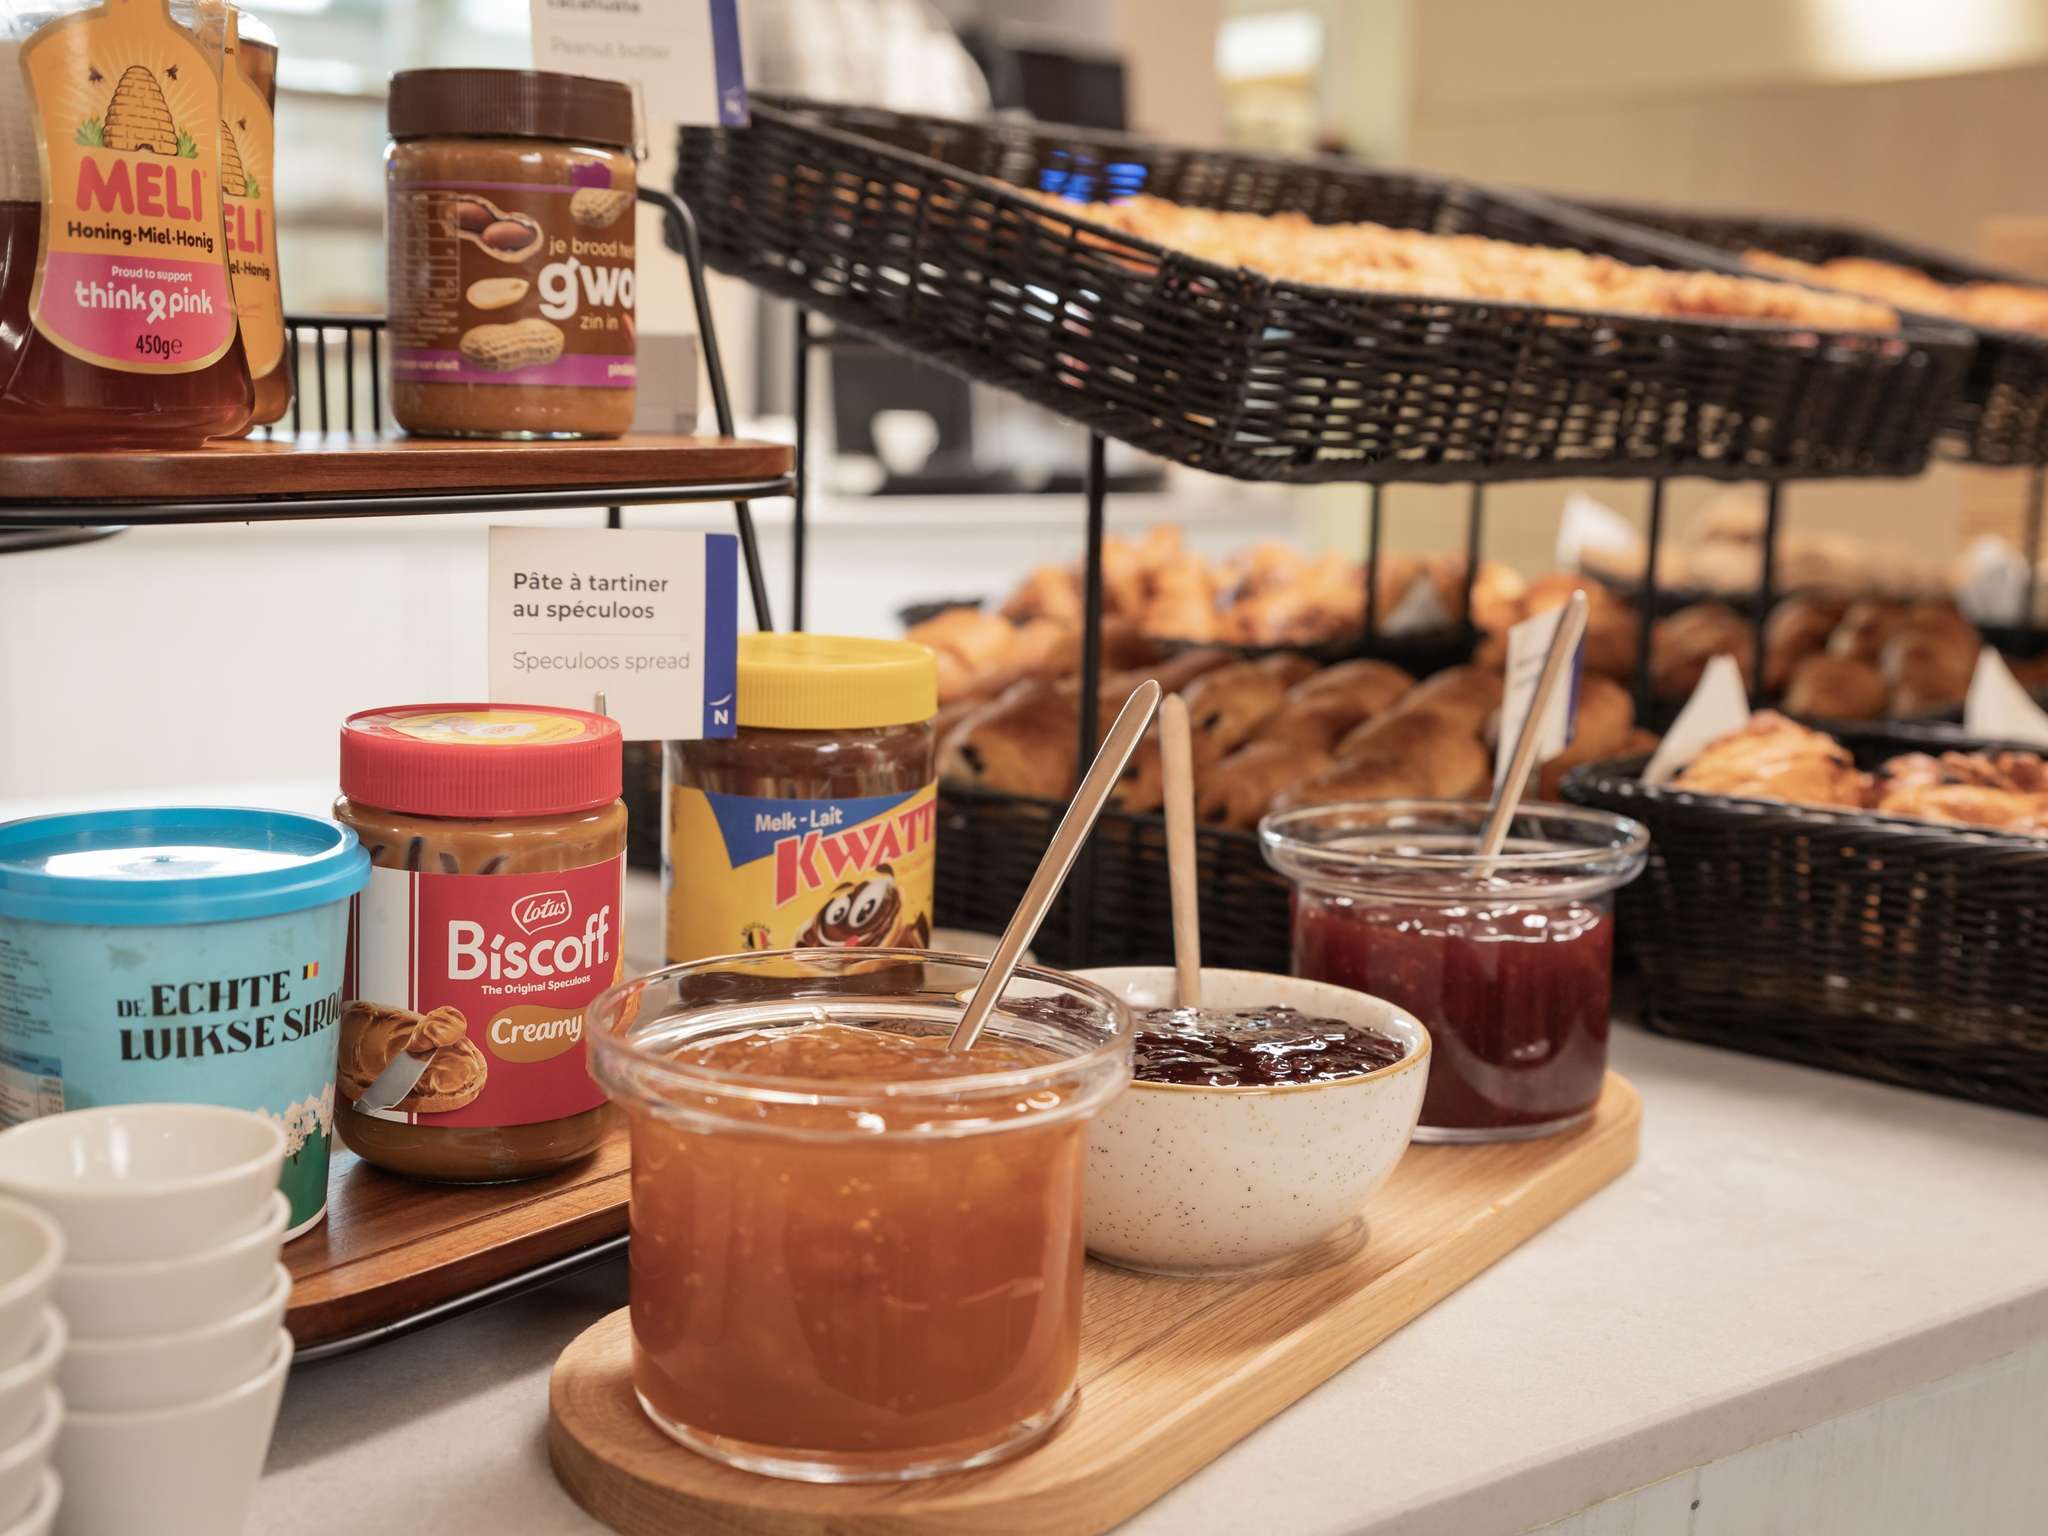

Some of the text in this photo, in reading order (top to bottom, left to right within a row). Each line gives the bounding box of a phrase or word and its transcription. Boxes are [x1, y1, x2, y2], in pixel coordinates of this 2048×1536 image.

[76, 156, 203, 222] MELI
[223, 203, 265, 254] ELI
[548, 235, 567, 257] je
[571, 237, 617, 257] brood
[112, 266, 192, 283] Proud to support
[75, 281, 213, 316] think pink
[579, 312, 604, 330] zin
[513, 573, 669, 592] Pâte à tartiner
[513, 600, 655, 621] au spéculoos
[513, 651, 690, 673] Speculoos spread
[755, 815, 796, 833] Melk
[810, 807, 843, 829] Lait
[523, 898, 568, 924] Lotus
[447, 906, 610, 981] Biscoff
[117, 970, 291, 1018] DE ECHTE
[481, 974, 591, 996] The Original Speculoos
[120, 1014, 276, 1061] LUIKSE
[491, 1016, 583, 1044] Creamy
